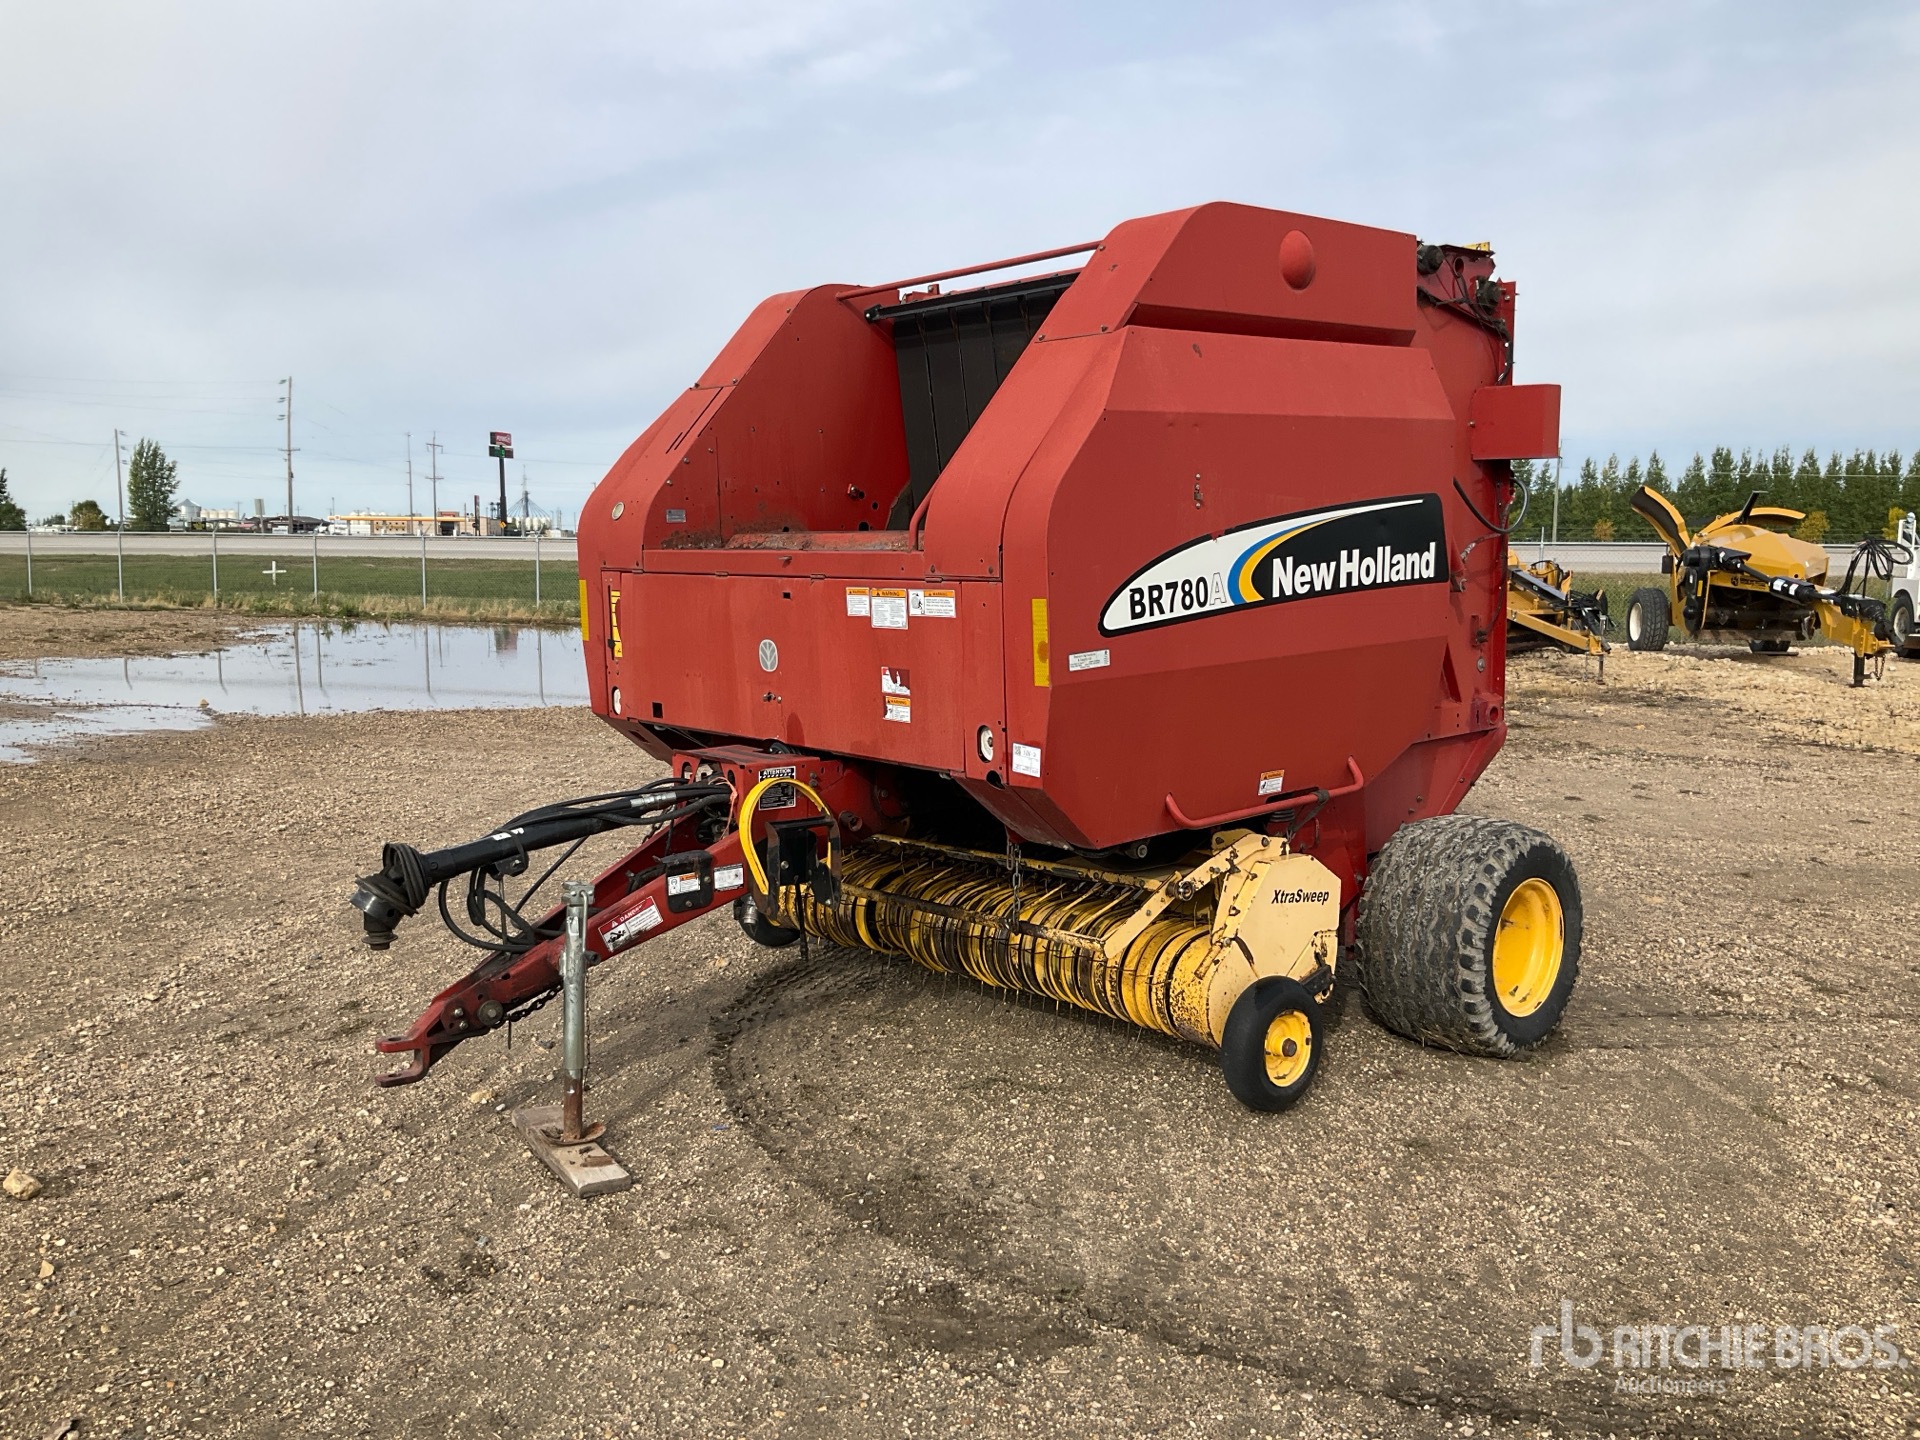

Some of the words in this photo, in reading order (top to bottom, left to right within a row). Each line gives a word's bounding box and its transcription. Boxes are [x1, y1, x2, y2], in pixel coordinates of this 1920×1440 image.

[1272, 556, 1336, 598] New
[1340, 541, 1436, 588] Holland
[1129, 572, 1227, 620] BR780A
[1271, 888, 1330, 905] XtraSweep
